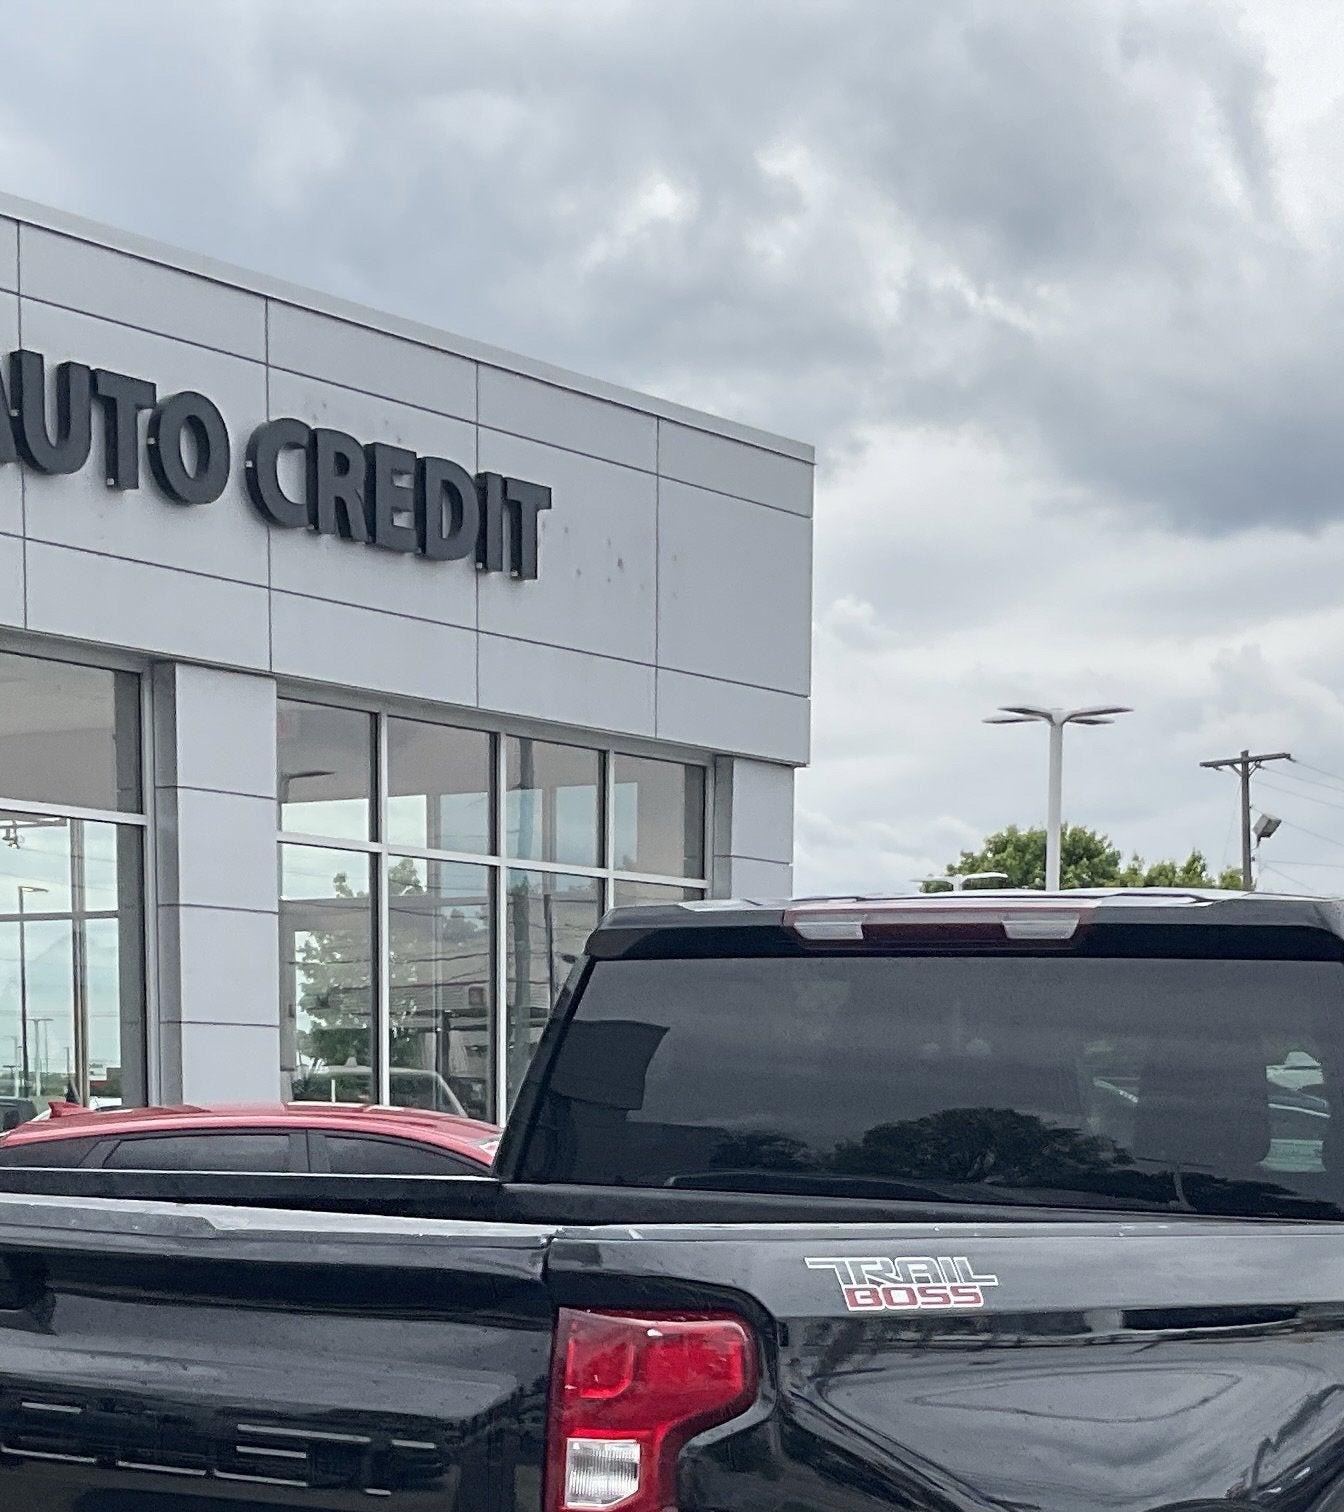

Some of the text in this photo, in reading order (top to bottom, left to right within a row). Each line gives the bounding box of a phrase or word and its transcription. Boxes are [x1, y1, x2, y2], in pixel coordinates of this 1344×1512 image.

[245, 417, 552, 580] CREDIT
[805, 1256, 999, 1287] TRAIL
[843, 1284, 984, 1311] BOSS
